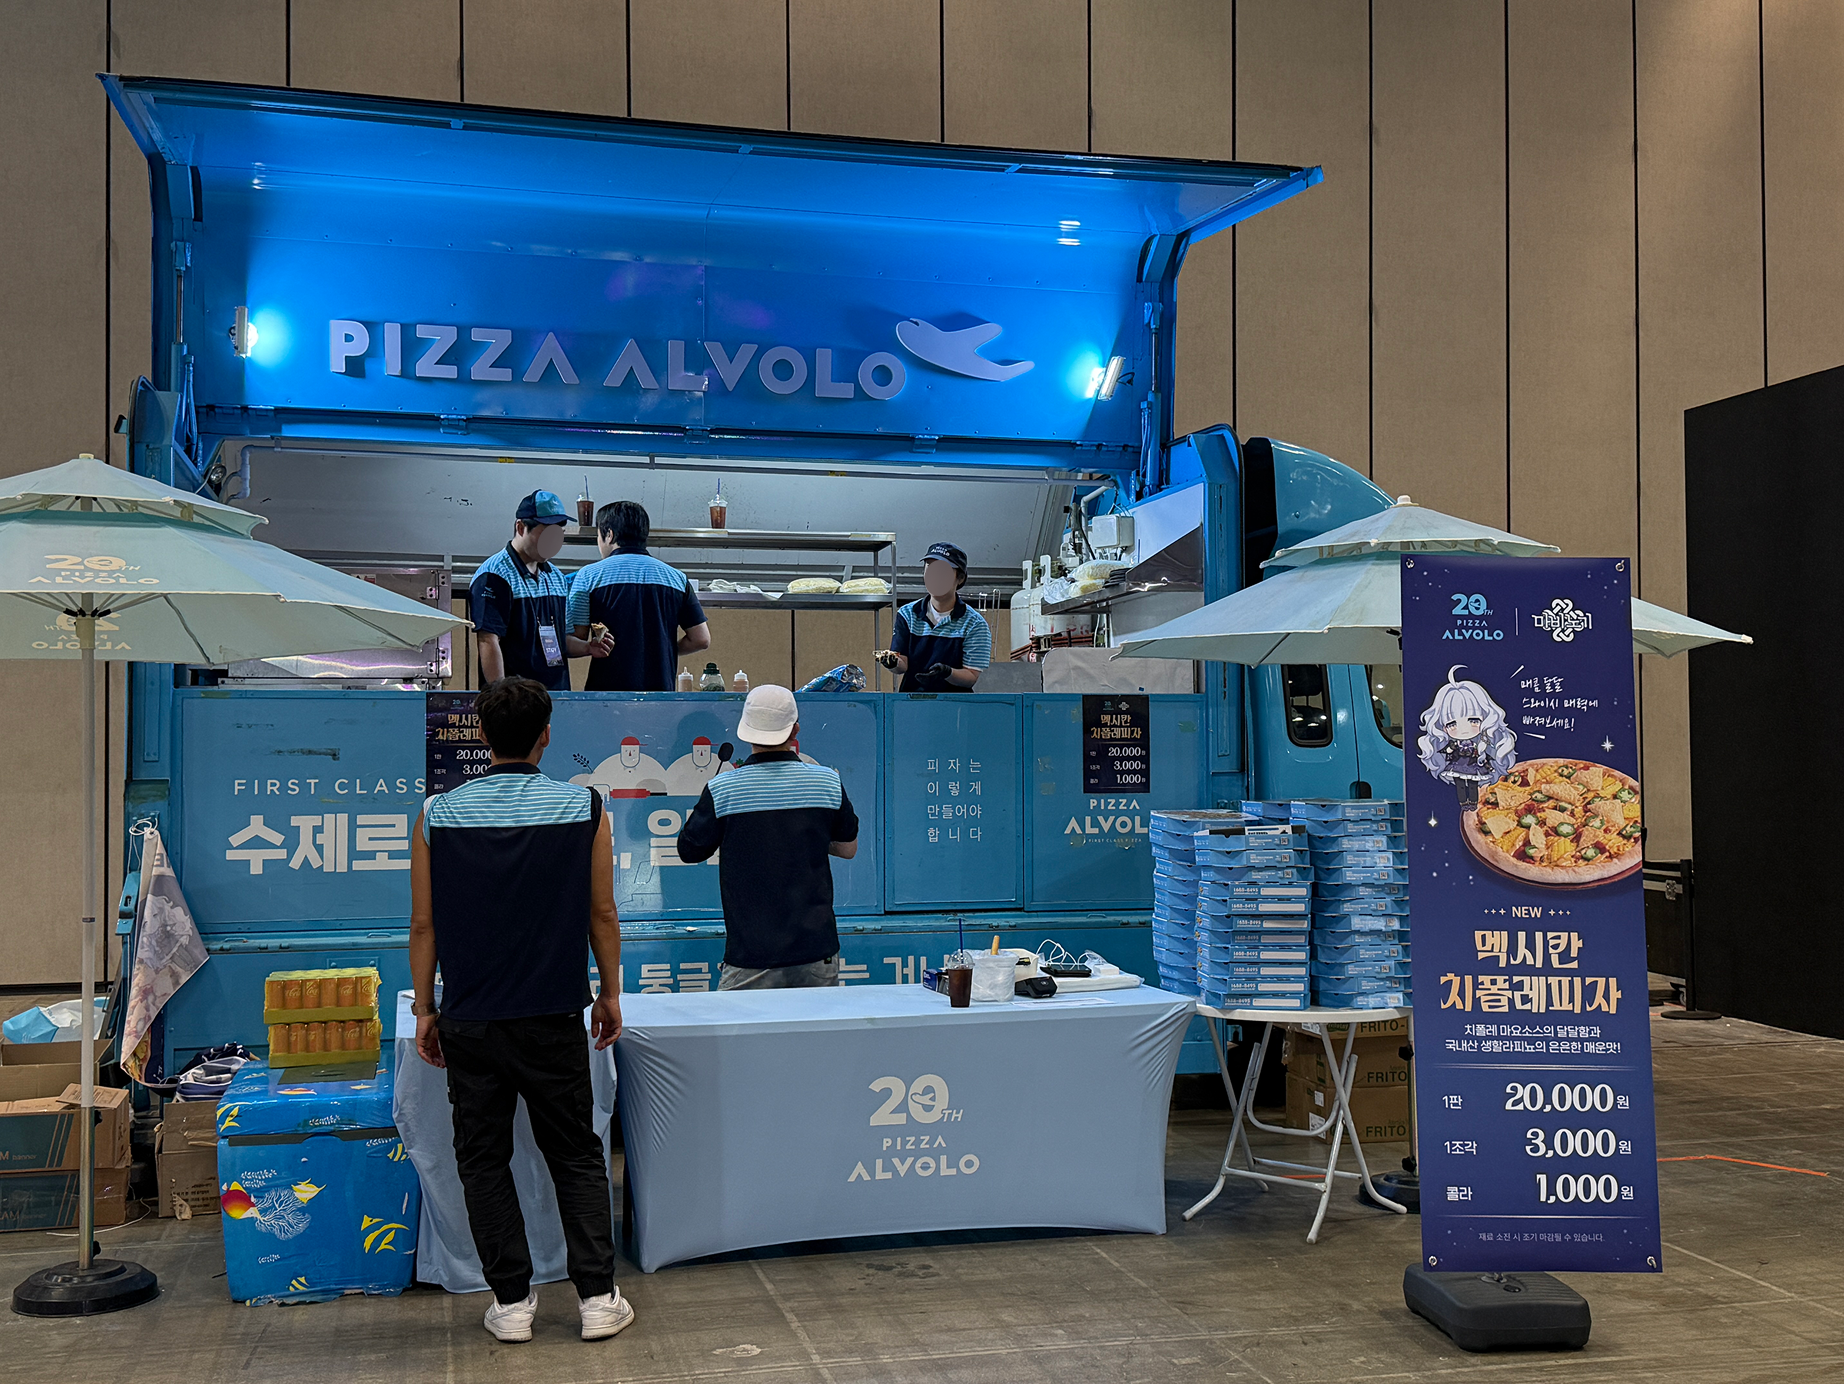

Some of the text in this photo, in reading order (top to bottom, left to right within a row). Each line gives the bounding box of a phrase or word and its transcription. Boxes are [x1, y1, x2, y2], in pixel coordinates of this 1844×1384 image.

[329, 319, 907, 401] PIZZA ALVOLO
[28, 576, 160, 585] ALVOLO
[1450, 593, 1494, 616] 20TH
[1456, 619, 1488, 627] PIZZA
[1442, 629, 1504, 641] ALVOLO
[1520, 676, 1564, 693] 매콤 달달
[1522, 697, 1599, 712] 스와이시 매력에
[927, 758, 982, 774] 피자는
[234, 777, 426, 796] FIRST CLASS
[927, 781, 982, 797] 이렇게
[927, 804, 982, 820] 만들어야
[1089, 799, 1141, 810] PIZZA
[1064, 816, 1149, 834] ALVOL
[927, 827, 982, 843] 합니다
[225, 813, 412, 875] 수제로
[1511, 906, 1543, 918] NEW
[1474, 930, 1583, 969] 멕시칸
[1439, 973, 1622, 1014] 치폴레피자
[1360, 1020, 1409, 1033] FRITO-
[1464, 1024, 1601, 1038] 치폴레 마요소스의 달달함과
[1445, 1039, 1621, 1054] 국내산 생할라피뇨의 은은한 매운맛!
[868, 1073, 964, 1127] 20TH
[1442, 1095, 1463, 1110] 1판
[882, 1135, 947, 1150] PIZZA
[1444, 1140, 1478, 1155] 1조각
[847, 1153, 980, 1182] ALVOLO
[1446, 1186, 1473, 1201] 콜라
[0, 1210, 20, 1221] AM
[1479, 1232, 1494, 1241] 재료
[1496, 1232, 1511, 1242] 소진
[1513, 1232, 1521, 1241] 시
[1522, 1232, 1538, 1241] 조기
[1539, 1232, 1562, 1242] 마감될
[1564, 1233, 1572, 1242] 수
